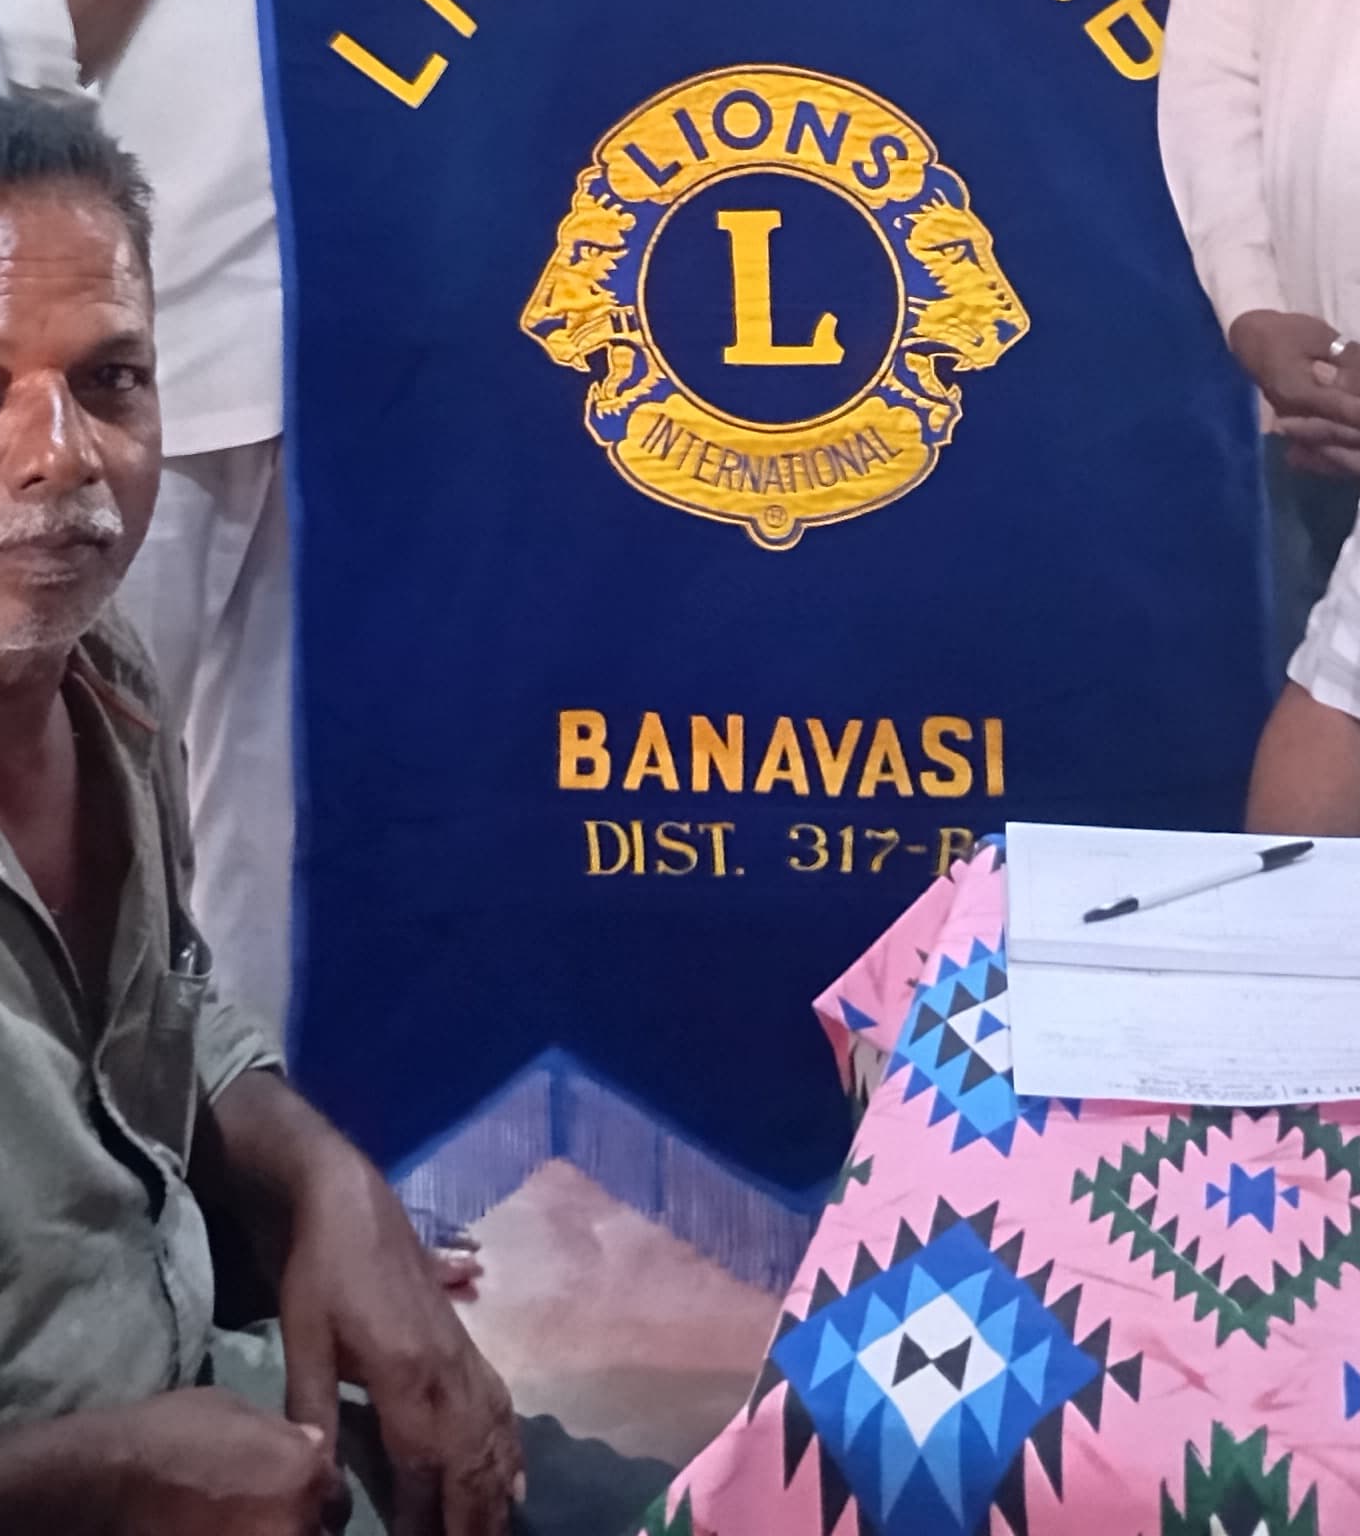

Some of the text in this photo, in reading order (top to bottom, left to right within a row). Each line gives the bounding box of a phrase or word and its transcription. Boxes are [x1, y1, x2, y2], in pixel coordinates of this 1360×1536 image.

[623, 88, 909, 190] LIONS
[716, 209, 844, 366] L
[639, 412, 904, 494] INTERNATIONAL
[558, 708, 1007, 799] BANAVASI
[583, 819, 746, 877] DIST.
